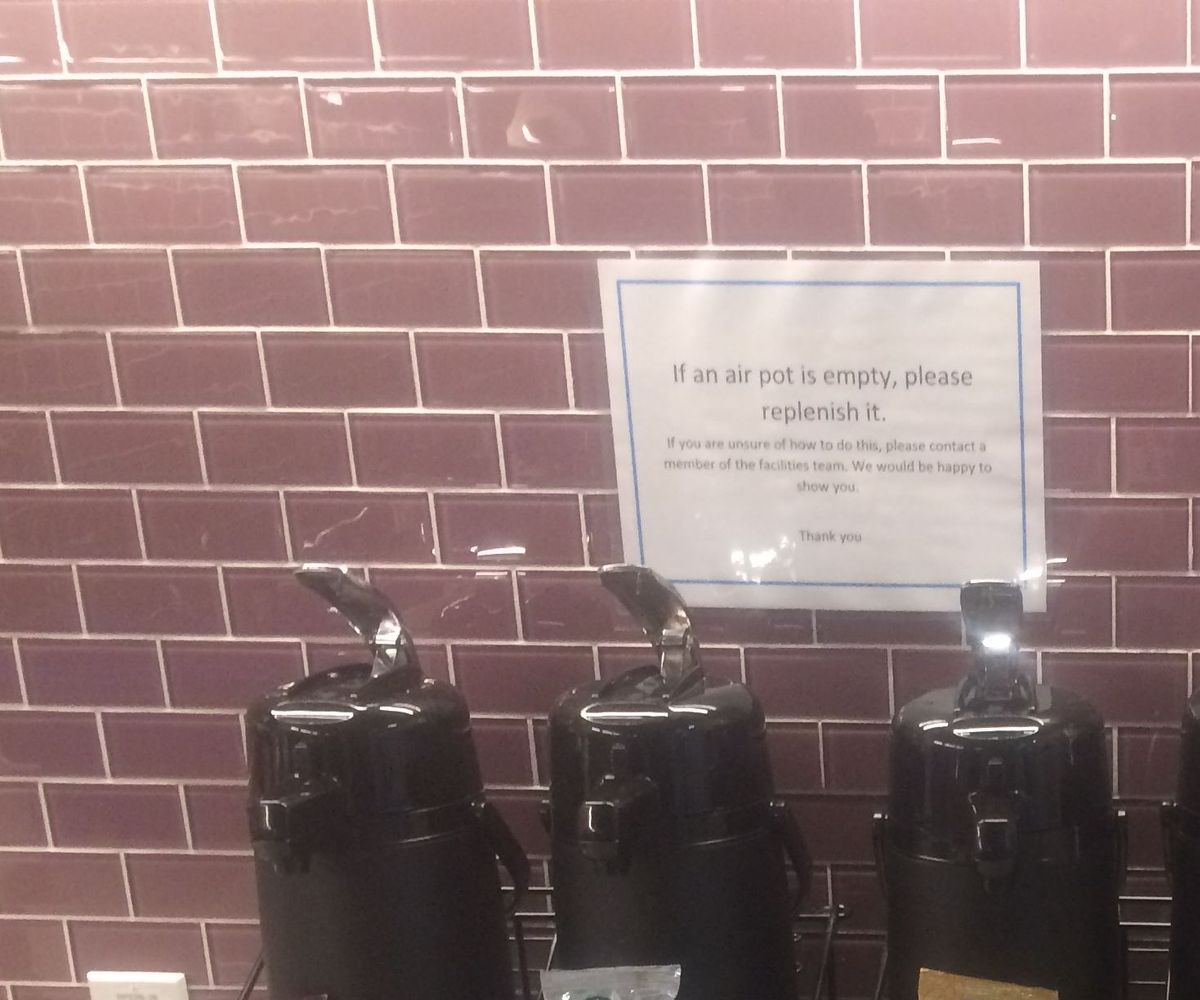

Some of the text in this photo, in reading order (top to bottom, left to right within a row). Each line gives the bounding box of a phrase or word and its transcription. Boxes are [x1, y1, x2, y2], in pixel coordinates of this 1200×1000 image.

[673, 363, 973, 390] If an air pot is empty, please
[762, 400, 886, 425] replenish it.
[667, 437, 986, 454] If you are unsure of how to do this, please contact a
[664, 458, 992, 475] member of the facilities team. We would be happy to
[797, 480, 859, 494] show you.
[799, 530, 862, 544] Thank you
